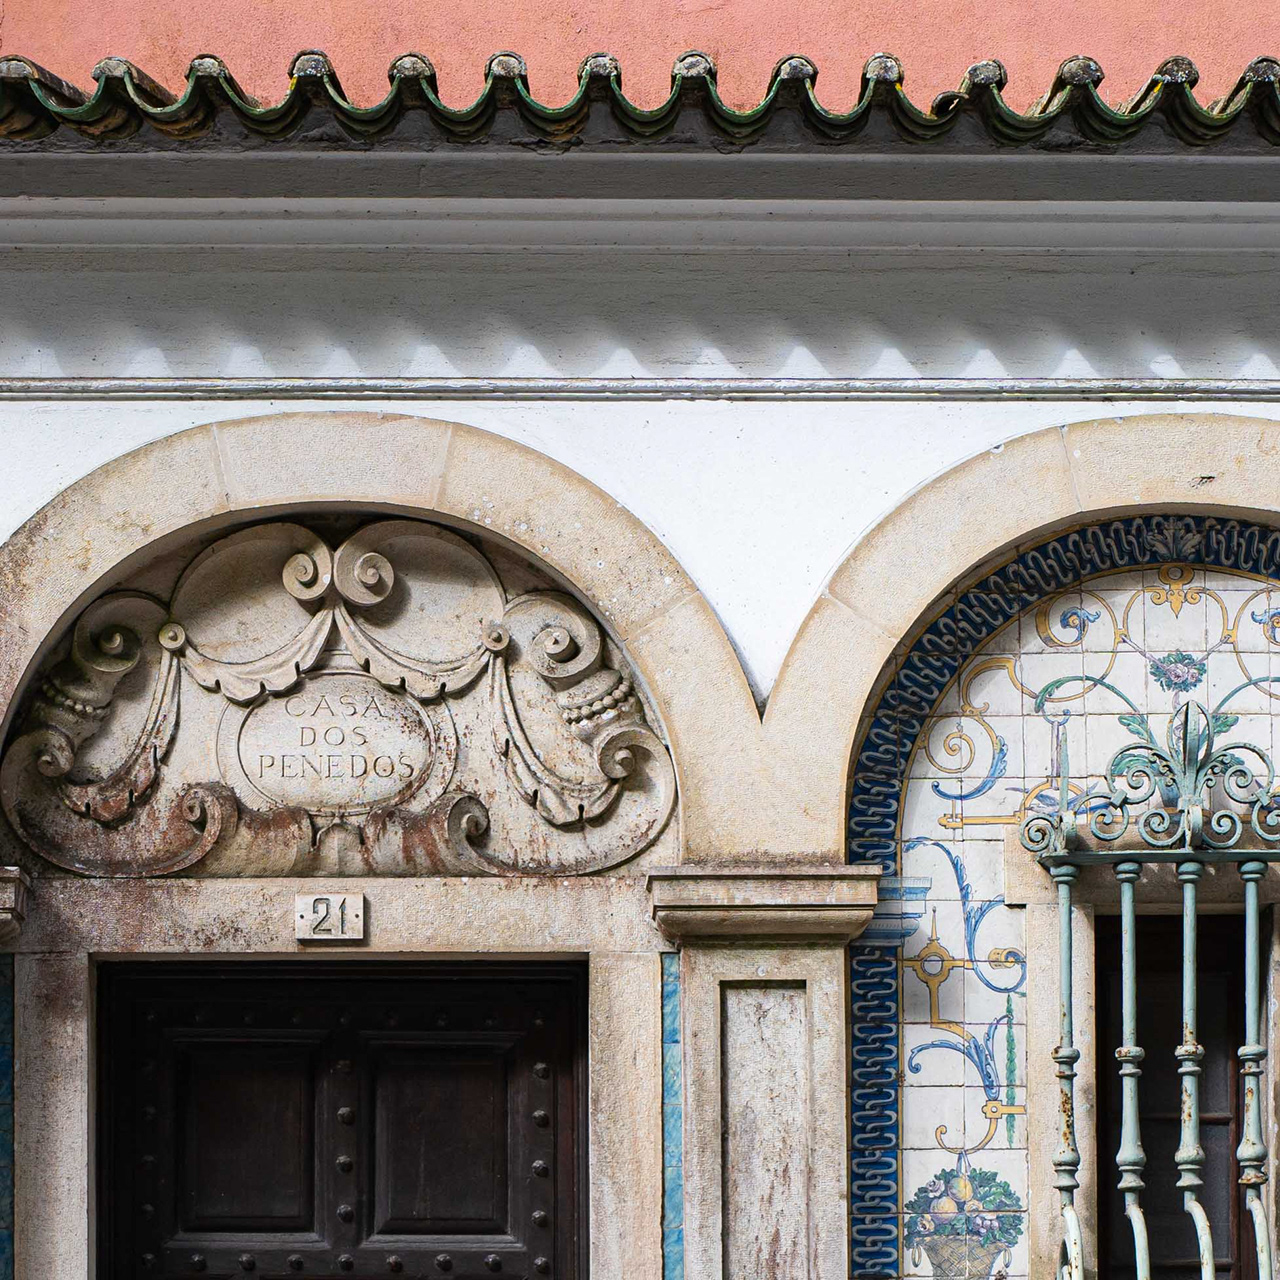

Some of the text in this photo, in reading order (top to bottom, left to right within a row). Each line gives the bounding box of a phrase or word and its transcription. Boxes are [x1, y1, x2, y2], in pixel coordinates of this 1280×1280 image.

[284, 694, 388, 718] CASA
[299, 725, 368, 747] DOS
[258, 754, 415, 780] PENEDOS
[311, 897, 348, 935] 21
